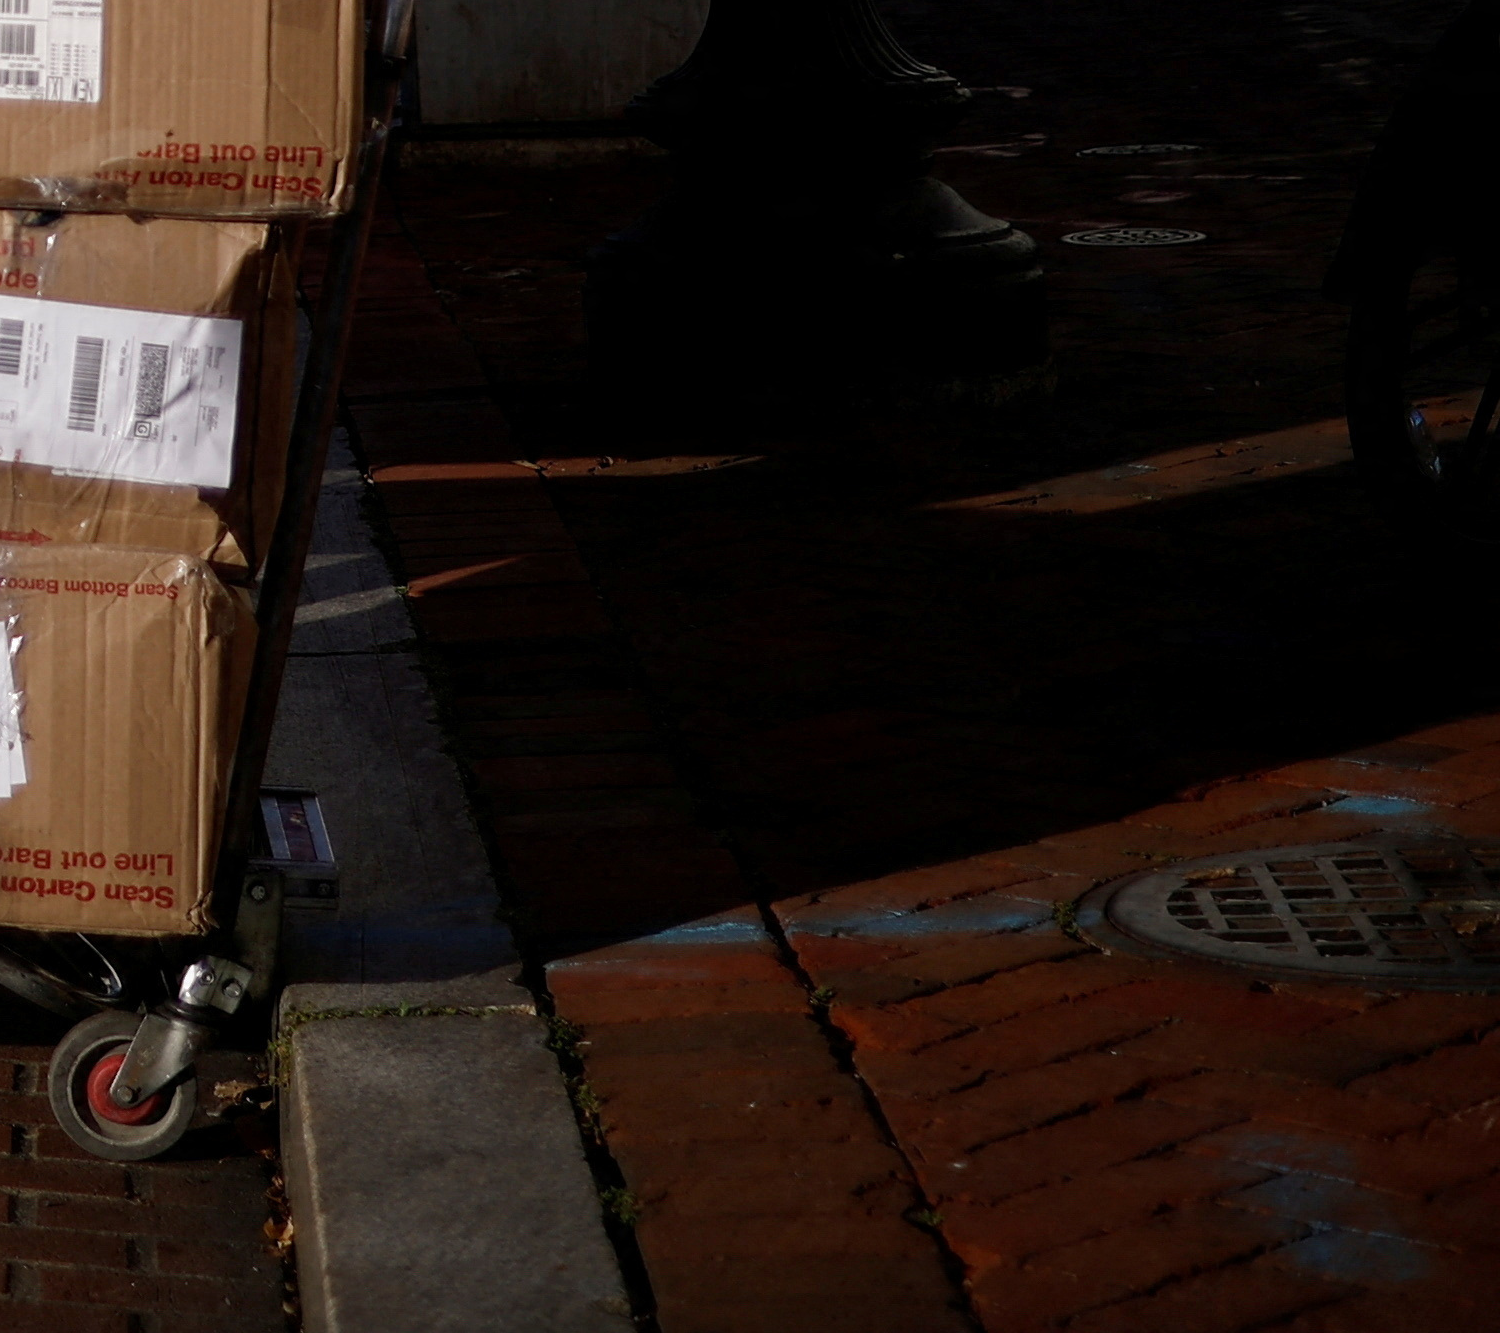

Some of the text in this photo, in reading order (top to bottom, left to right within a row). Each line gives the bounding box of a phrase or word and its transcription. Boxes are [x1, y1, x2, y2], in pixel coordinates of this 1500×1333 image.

[210, 143, 256, 163] out
[265, 144, 324, 167] Line
[148, 171, 245, 191] Carton
[252, 174, 322, 199] Scan
[64, 579, 129, 597] Bottom
[134, 583, 179, 600] Scan
[61, 850, 106, 870] out
[114, 852, 173, 877] Line
[1, 874, 96, 902] Carton
[104, 883, 174, 910] Scan
